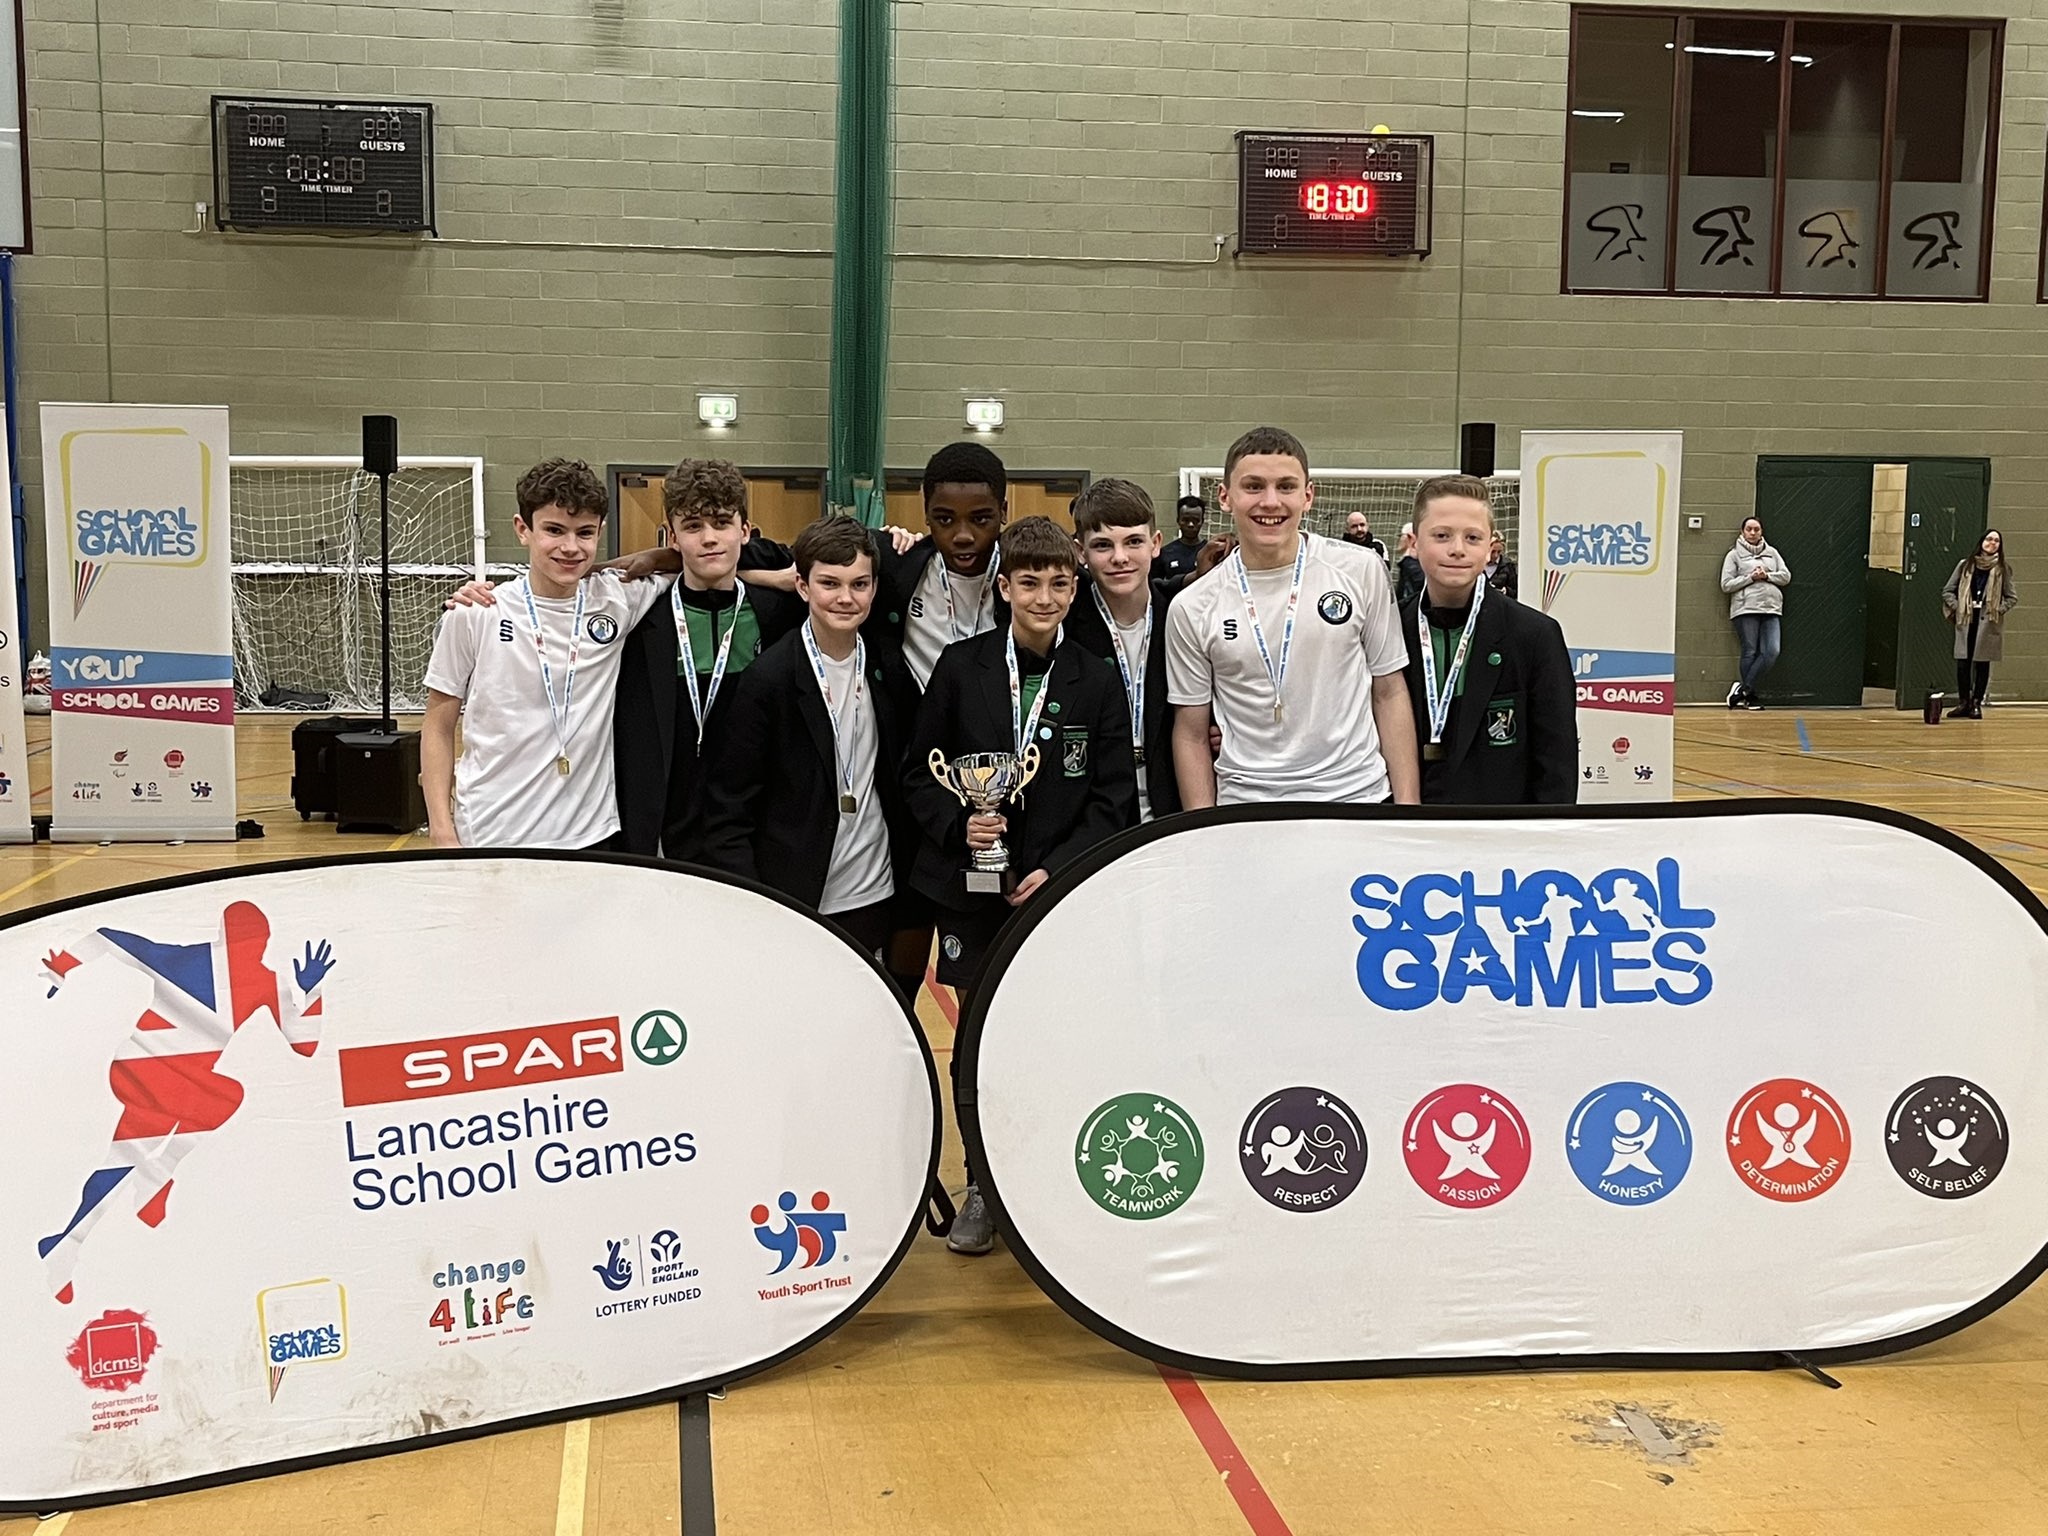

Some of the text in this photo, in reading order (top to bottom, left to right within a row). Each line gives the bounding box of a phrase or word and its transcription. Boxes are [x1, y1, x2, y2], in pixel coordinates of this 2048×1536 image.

[249, 137, 286, 148] HOME
[359, 140, 406, 152] GUESTS
[1265, 168, 1297, 178] HOME
[1362, 171, 1403, 182] GUESTS
[1308, 213, 1355, 221] TIME/TIMER
[76, 507, 198, 533] SCHOOL
[78, 527, 196, 557] GAMES
[1548, 521, 1651, 544] SCHOOL
[1548, 541, 1649, 566] GAMES
[62, 692, 220, 713] SCHOOL GAMES
[1602, 687, 1664, 704] GAMES
[1350, 857, 1715, 937] SCHOOL
[1356, 926, 1713, 1010] GAMES
[403, 1028, 617, 1089] SPAR
[345, 1094, 609, 1162] Lancashire
[353, 1132, 697, 1211] School Games
[1739, 1157, 1839, 1195] DETERMINATION
[1908, 1166, 1989, 1192] SELF BELIEF
[1101, 1187, 1184, 1213] TEAMWORK
[1273, 1185, 1339, 1206] RESPECT
[1438, 1183, 1502, 1202] PASSION
[1598, 1179, 1664, 1198] HONESTY
[432, 1259, 526, 1288] change
[651, 1261, 684, 1275] SPORT
[652, 1268, 699, 1284] ENGLAND
[758, 1276, 852, 1301] Youth Sport Trust
[595, 1287, 702, 1318] LOTTERY FUNDED
[429, 1299, 455, 1333] 4
[269, 1324, 341, 1349] SCHOOL
[270, 1338, 341, 1363] GAMES
[93, 1355, 139, 1374] dcms
[91, 1393, 158, 1411] department for
[92, 1403, 159, 1421] culture, media
[92, 1417, 139, 1432] and sport
